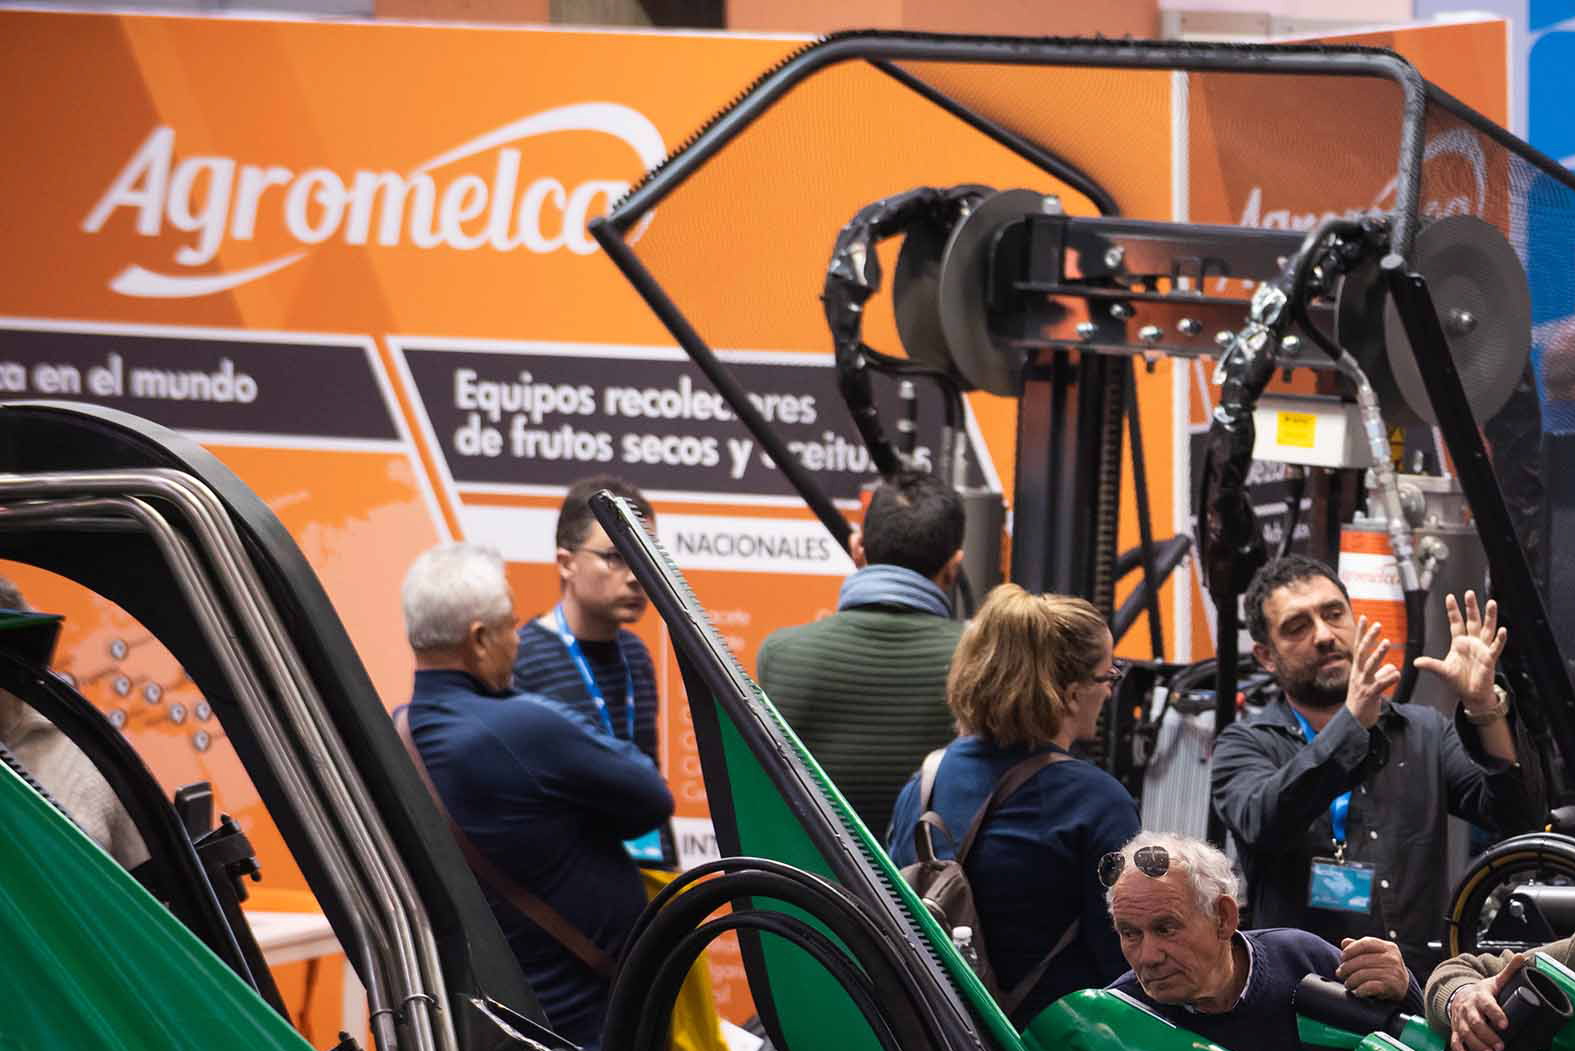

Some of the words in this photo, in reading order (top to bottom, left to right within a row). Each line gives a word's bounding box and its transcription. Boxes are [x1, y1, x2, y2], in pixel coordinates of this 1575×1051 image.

[80, 125, 634, 266] Agromelca
[33, 363, 81, 394] en
[86, 352, 123, 397] el
[130, 356, 258, 404] mundo
[454, 368, 596, 424] Equipos
[603, 374, 818, 424] recolecres
[454, 412, 503, 457] de
[511, 413, 615, 462] frutos
[621, 431, 720, 467] secos
[727, 438, 753, 480] y
[676, 532, 831, 562] NACIONALES
